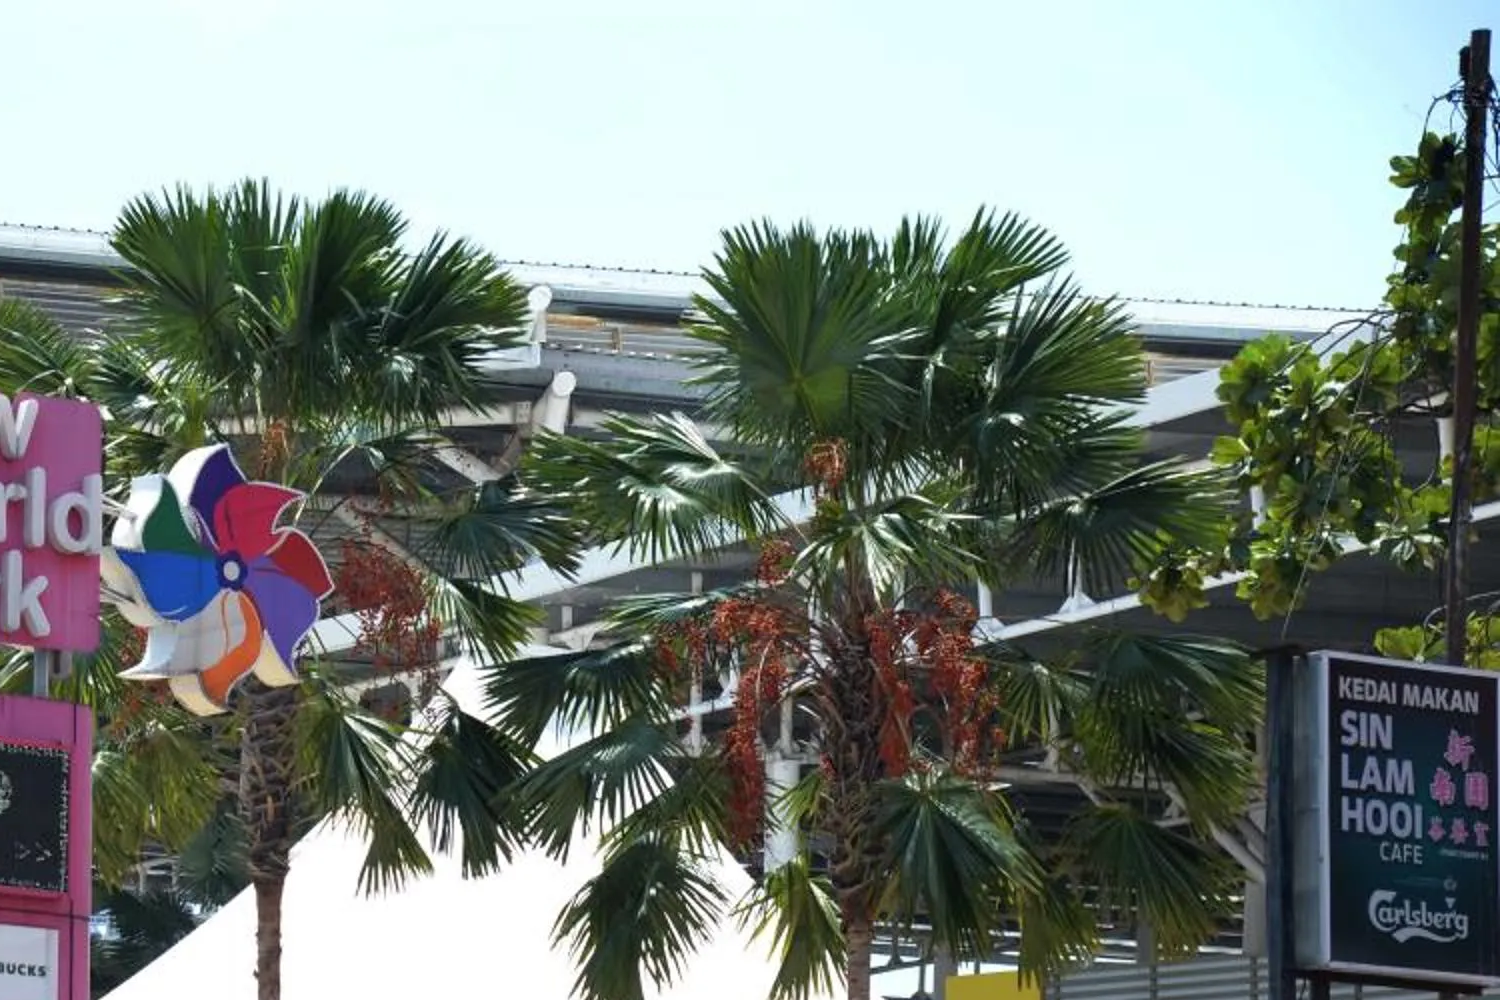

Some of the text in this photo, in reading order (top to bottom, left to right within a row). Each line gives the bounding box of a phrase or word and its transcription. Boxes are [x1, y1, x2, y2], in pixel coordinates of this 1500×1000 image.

[1339, 675, 1480, 715] KEDAI MAKAN
[1340, 709, 1393, 750] SIN
[1340, 752, 1415, 796] LAM
[1340, 796, 1424, 840] HOOI
[1379, 840, 1424, 865] CAFE
[1368, 889, 1469, 941] Carlsberg
